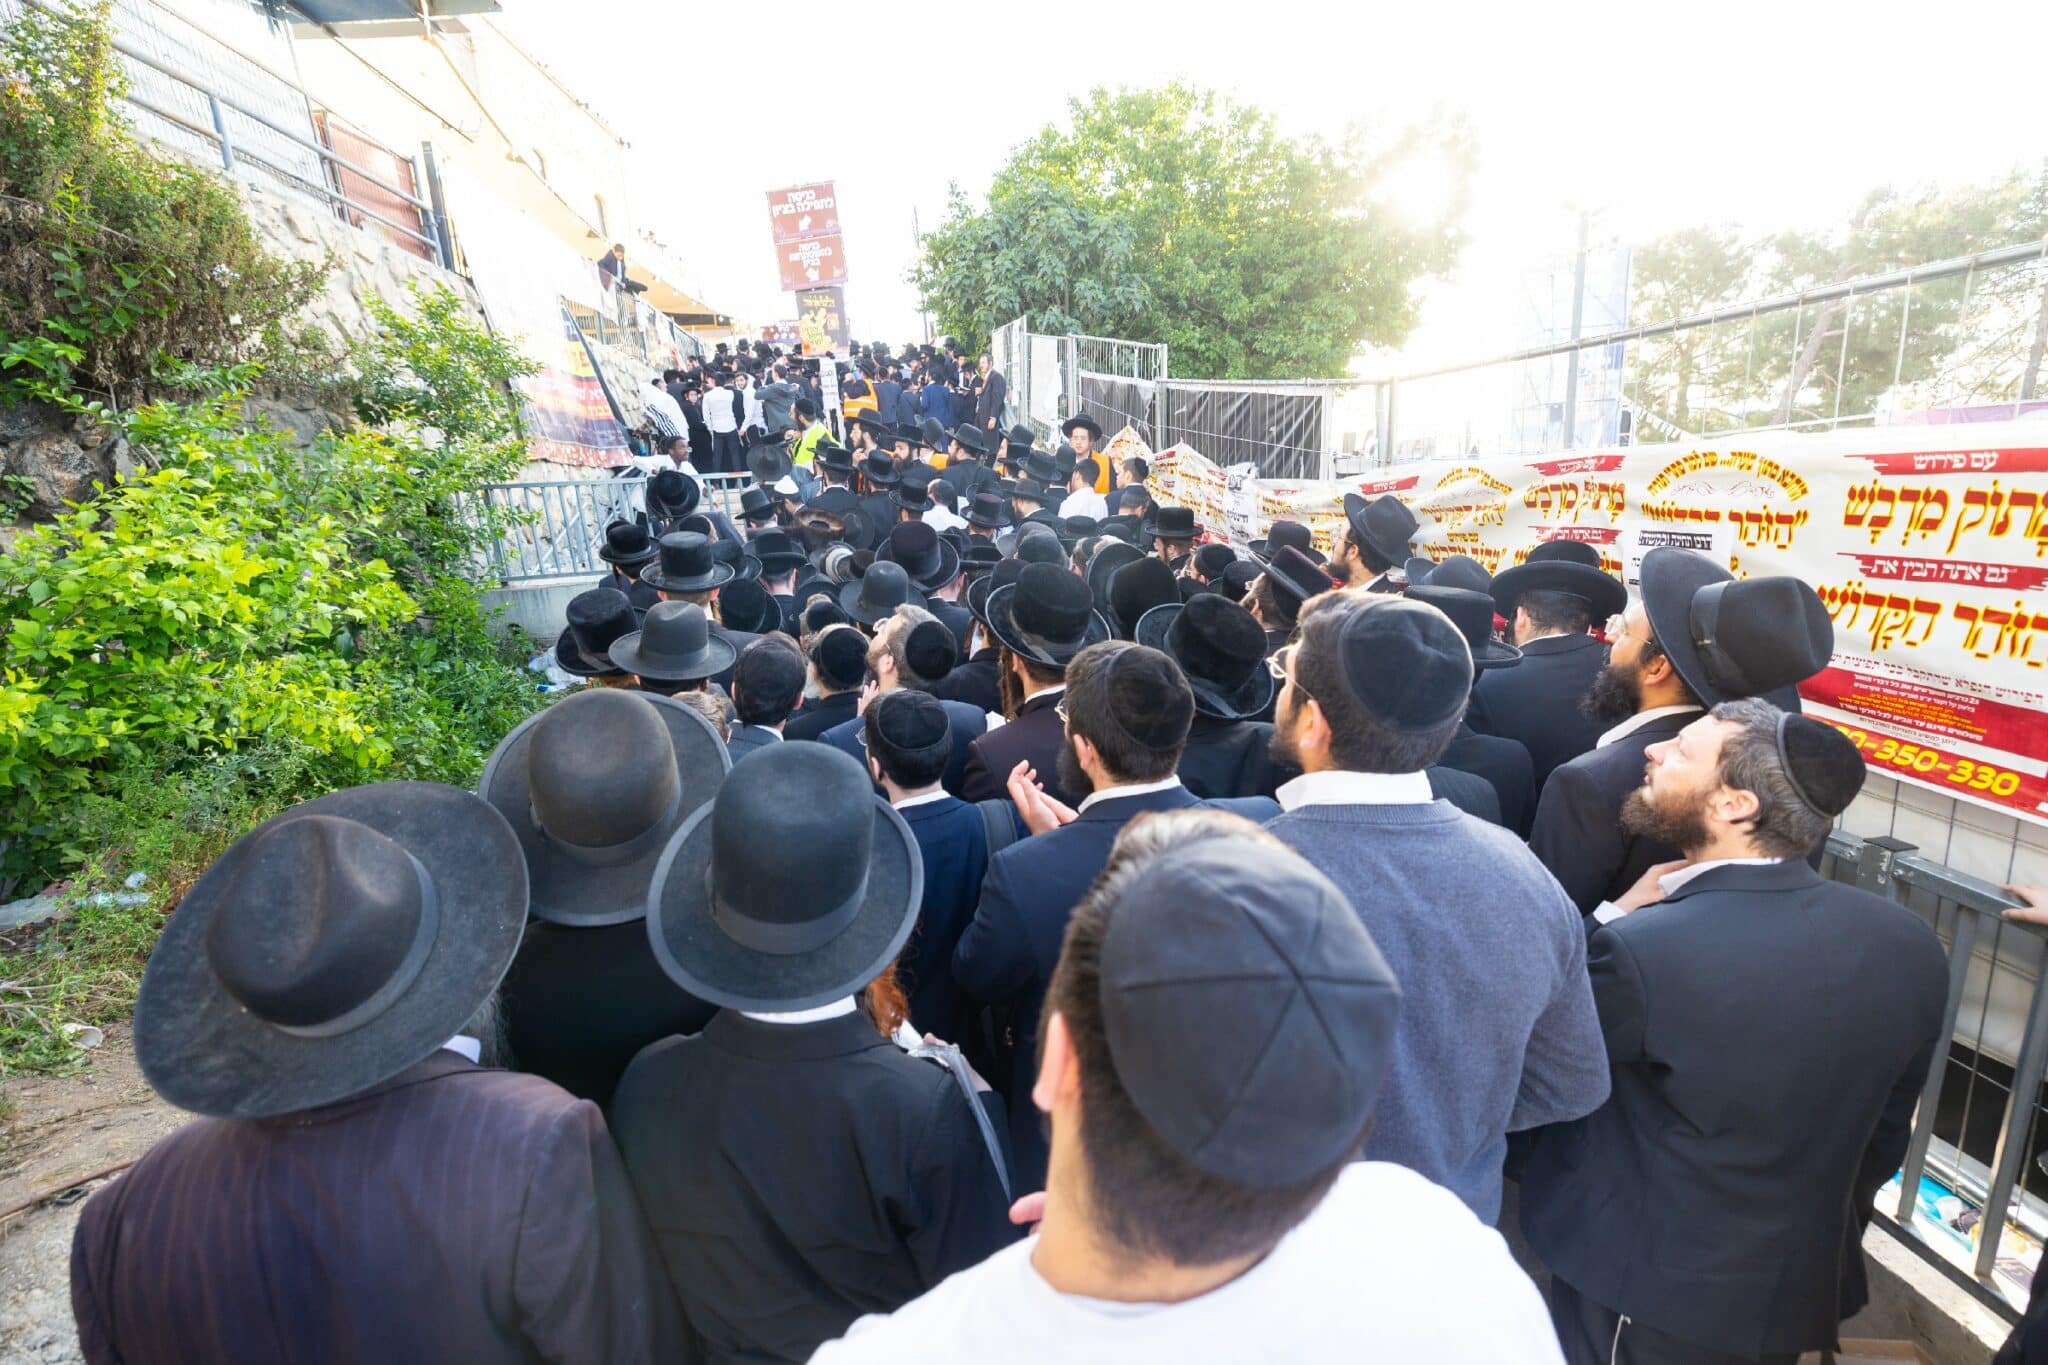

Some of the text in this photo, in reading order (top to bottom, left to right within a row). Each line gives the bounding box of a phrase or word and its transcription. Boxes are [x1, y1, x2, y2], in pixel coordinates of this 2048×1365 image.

[1913, 452, 1999, 471] עם פירוש
[1871, 559, 2010, 583] גם אתה תבין את
